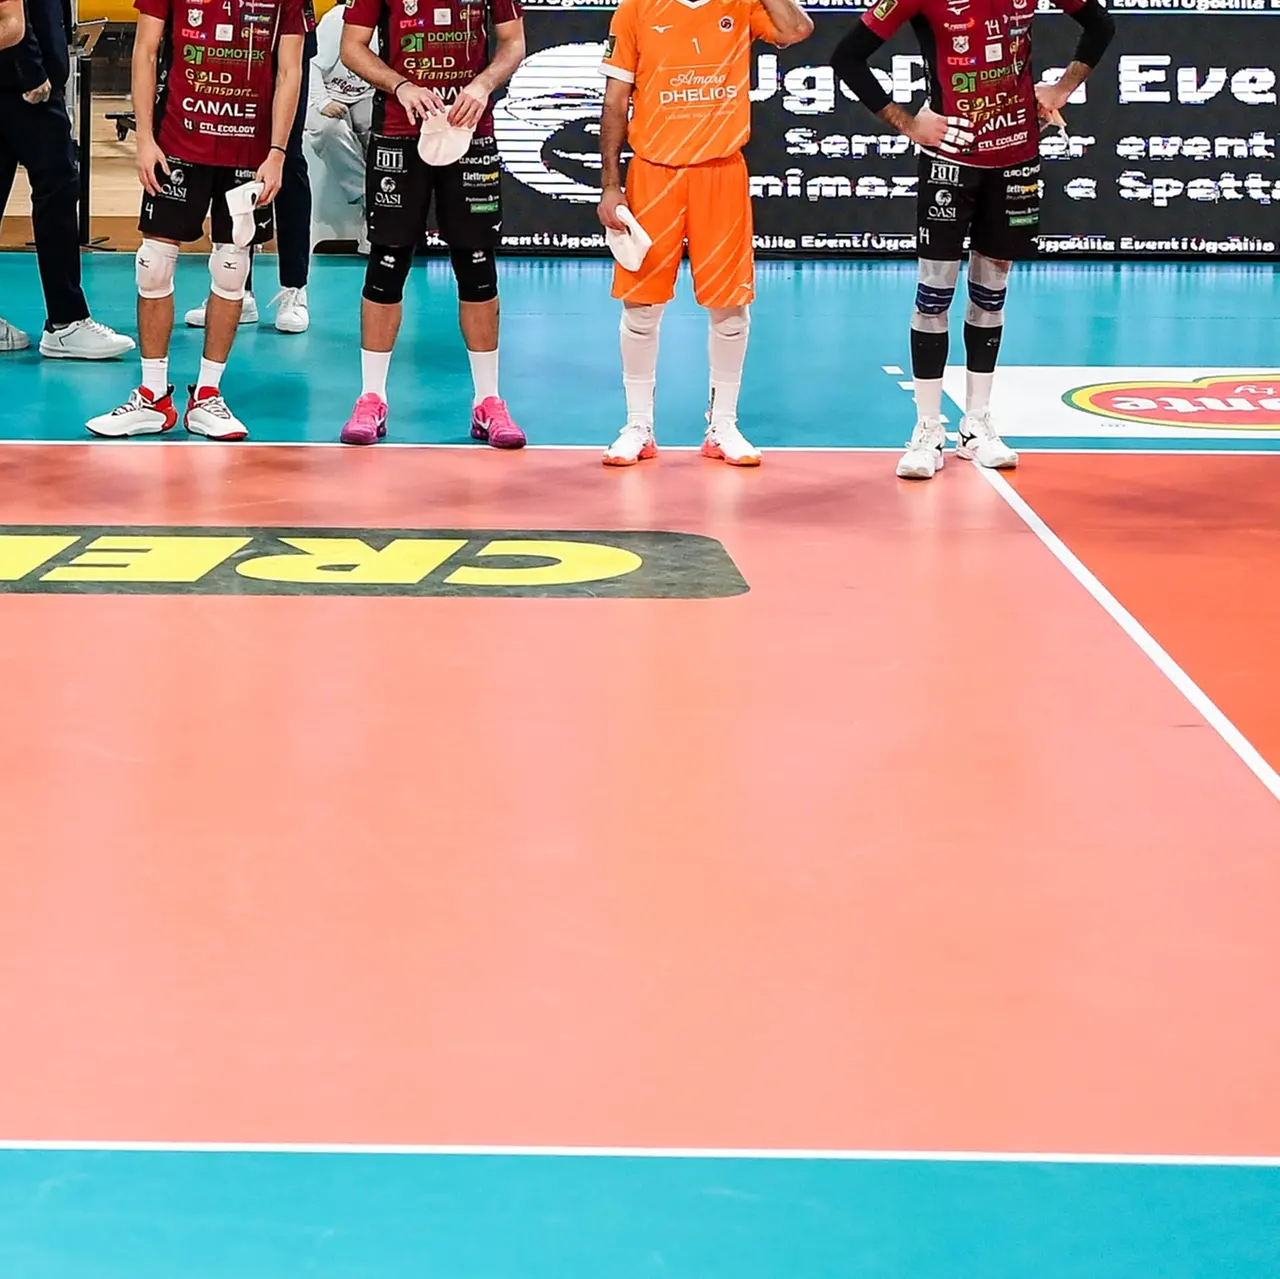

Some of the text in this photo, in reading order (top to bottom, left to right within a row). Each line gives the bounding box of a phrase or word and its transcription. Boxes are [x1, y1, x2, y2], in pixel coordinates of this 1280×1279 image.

[221, 0, 231, 16] 4
[984, 19, 1001, 36] 14
[207, 47, 265, 60] DOMOTEK
[691, 37, 701, 55] 1
[403, 56, 456, 69] GOLD
[185, 68, 232, 84] GOLD
[416, 69, 475, 81] Transport
[669, 70, 728, 87] Amaro
[194, 82, 252, 97] Transport
[659, 85, 739, 105] DHELIOS
[182, 97, 257, 117] CANALE
[217, 123, 255, 134] ECOLOGY
[160, 183, 188, 199] OASI
[375, 192, 401, 204] OASI
[145, 201, 154, 220] 4
[927, 205, 956, 218] OASI
